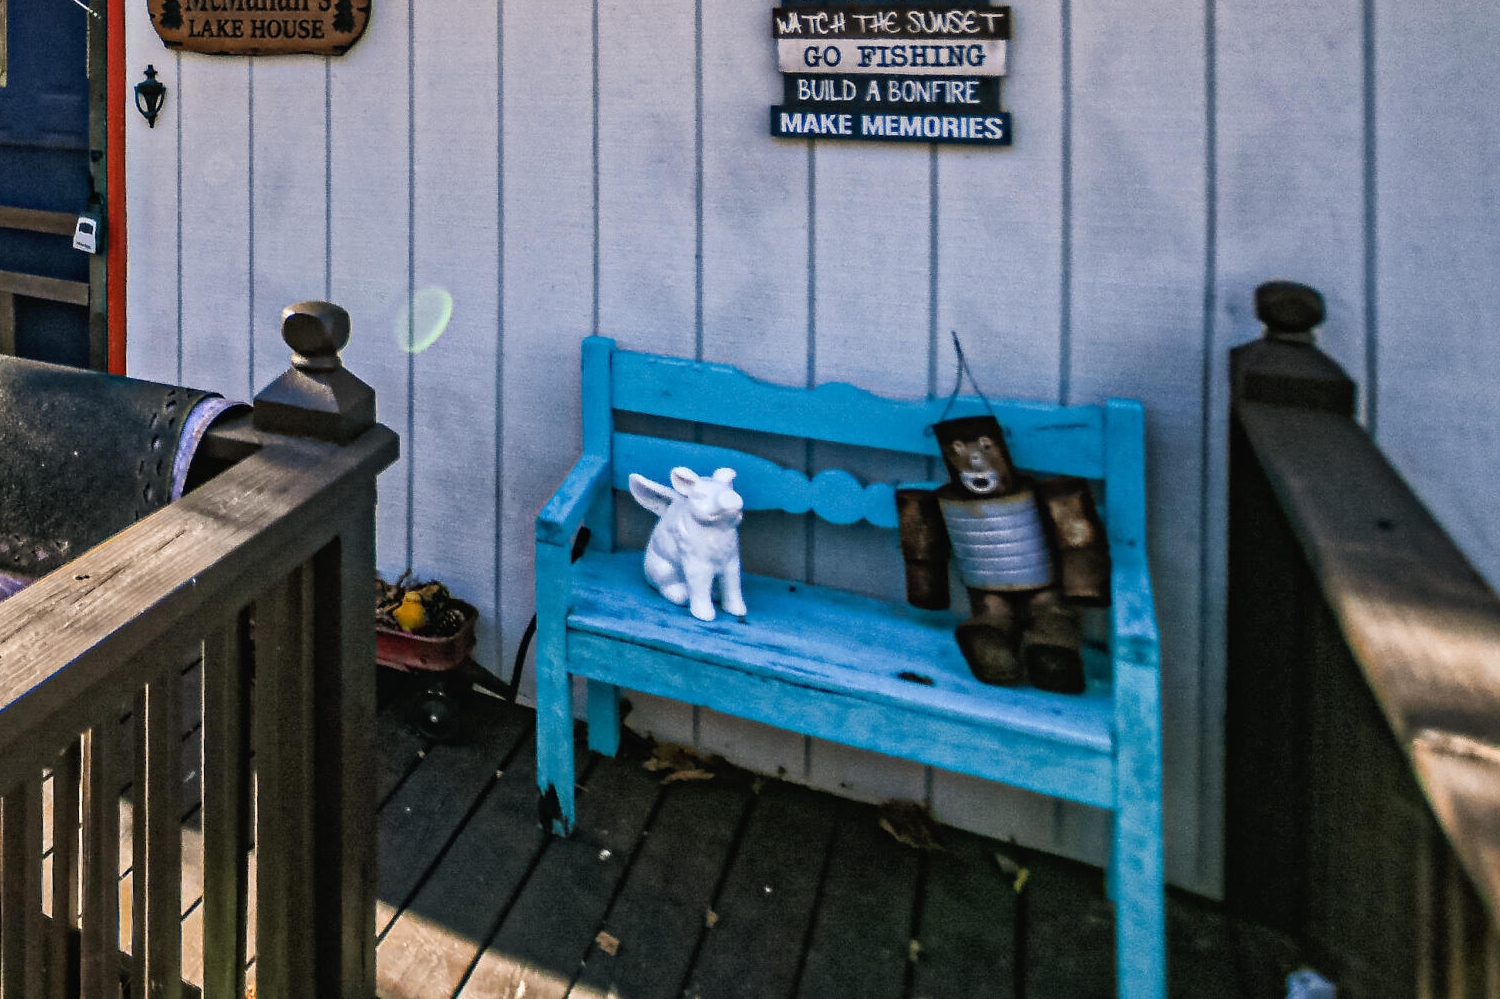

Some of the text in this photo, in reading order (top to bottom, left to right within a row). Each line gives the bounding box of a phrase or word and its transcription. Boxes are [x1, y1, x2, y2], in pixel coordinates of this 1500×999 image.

[188, 19, 325, 39] LAKE HOUSE
[776, 10, 1004, 34] WATCH THE SUNSET
[803, 44, 987, 68] GO FISHING
[797, 80, 980, 103] BUILD A BONFIRE
[780, 112, 1003, 139] MAKE MEMORIES
